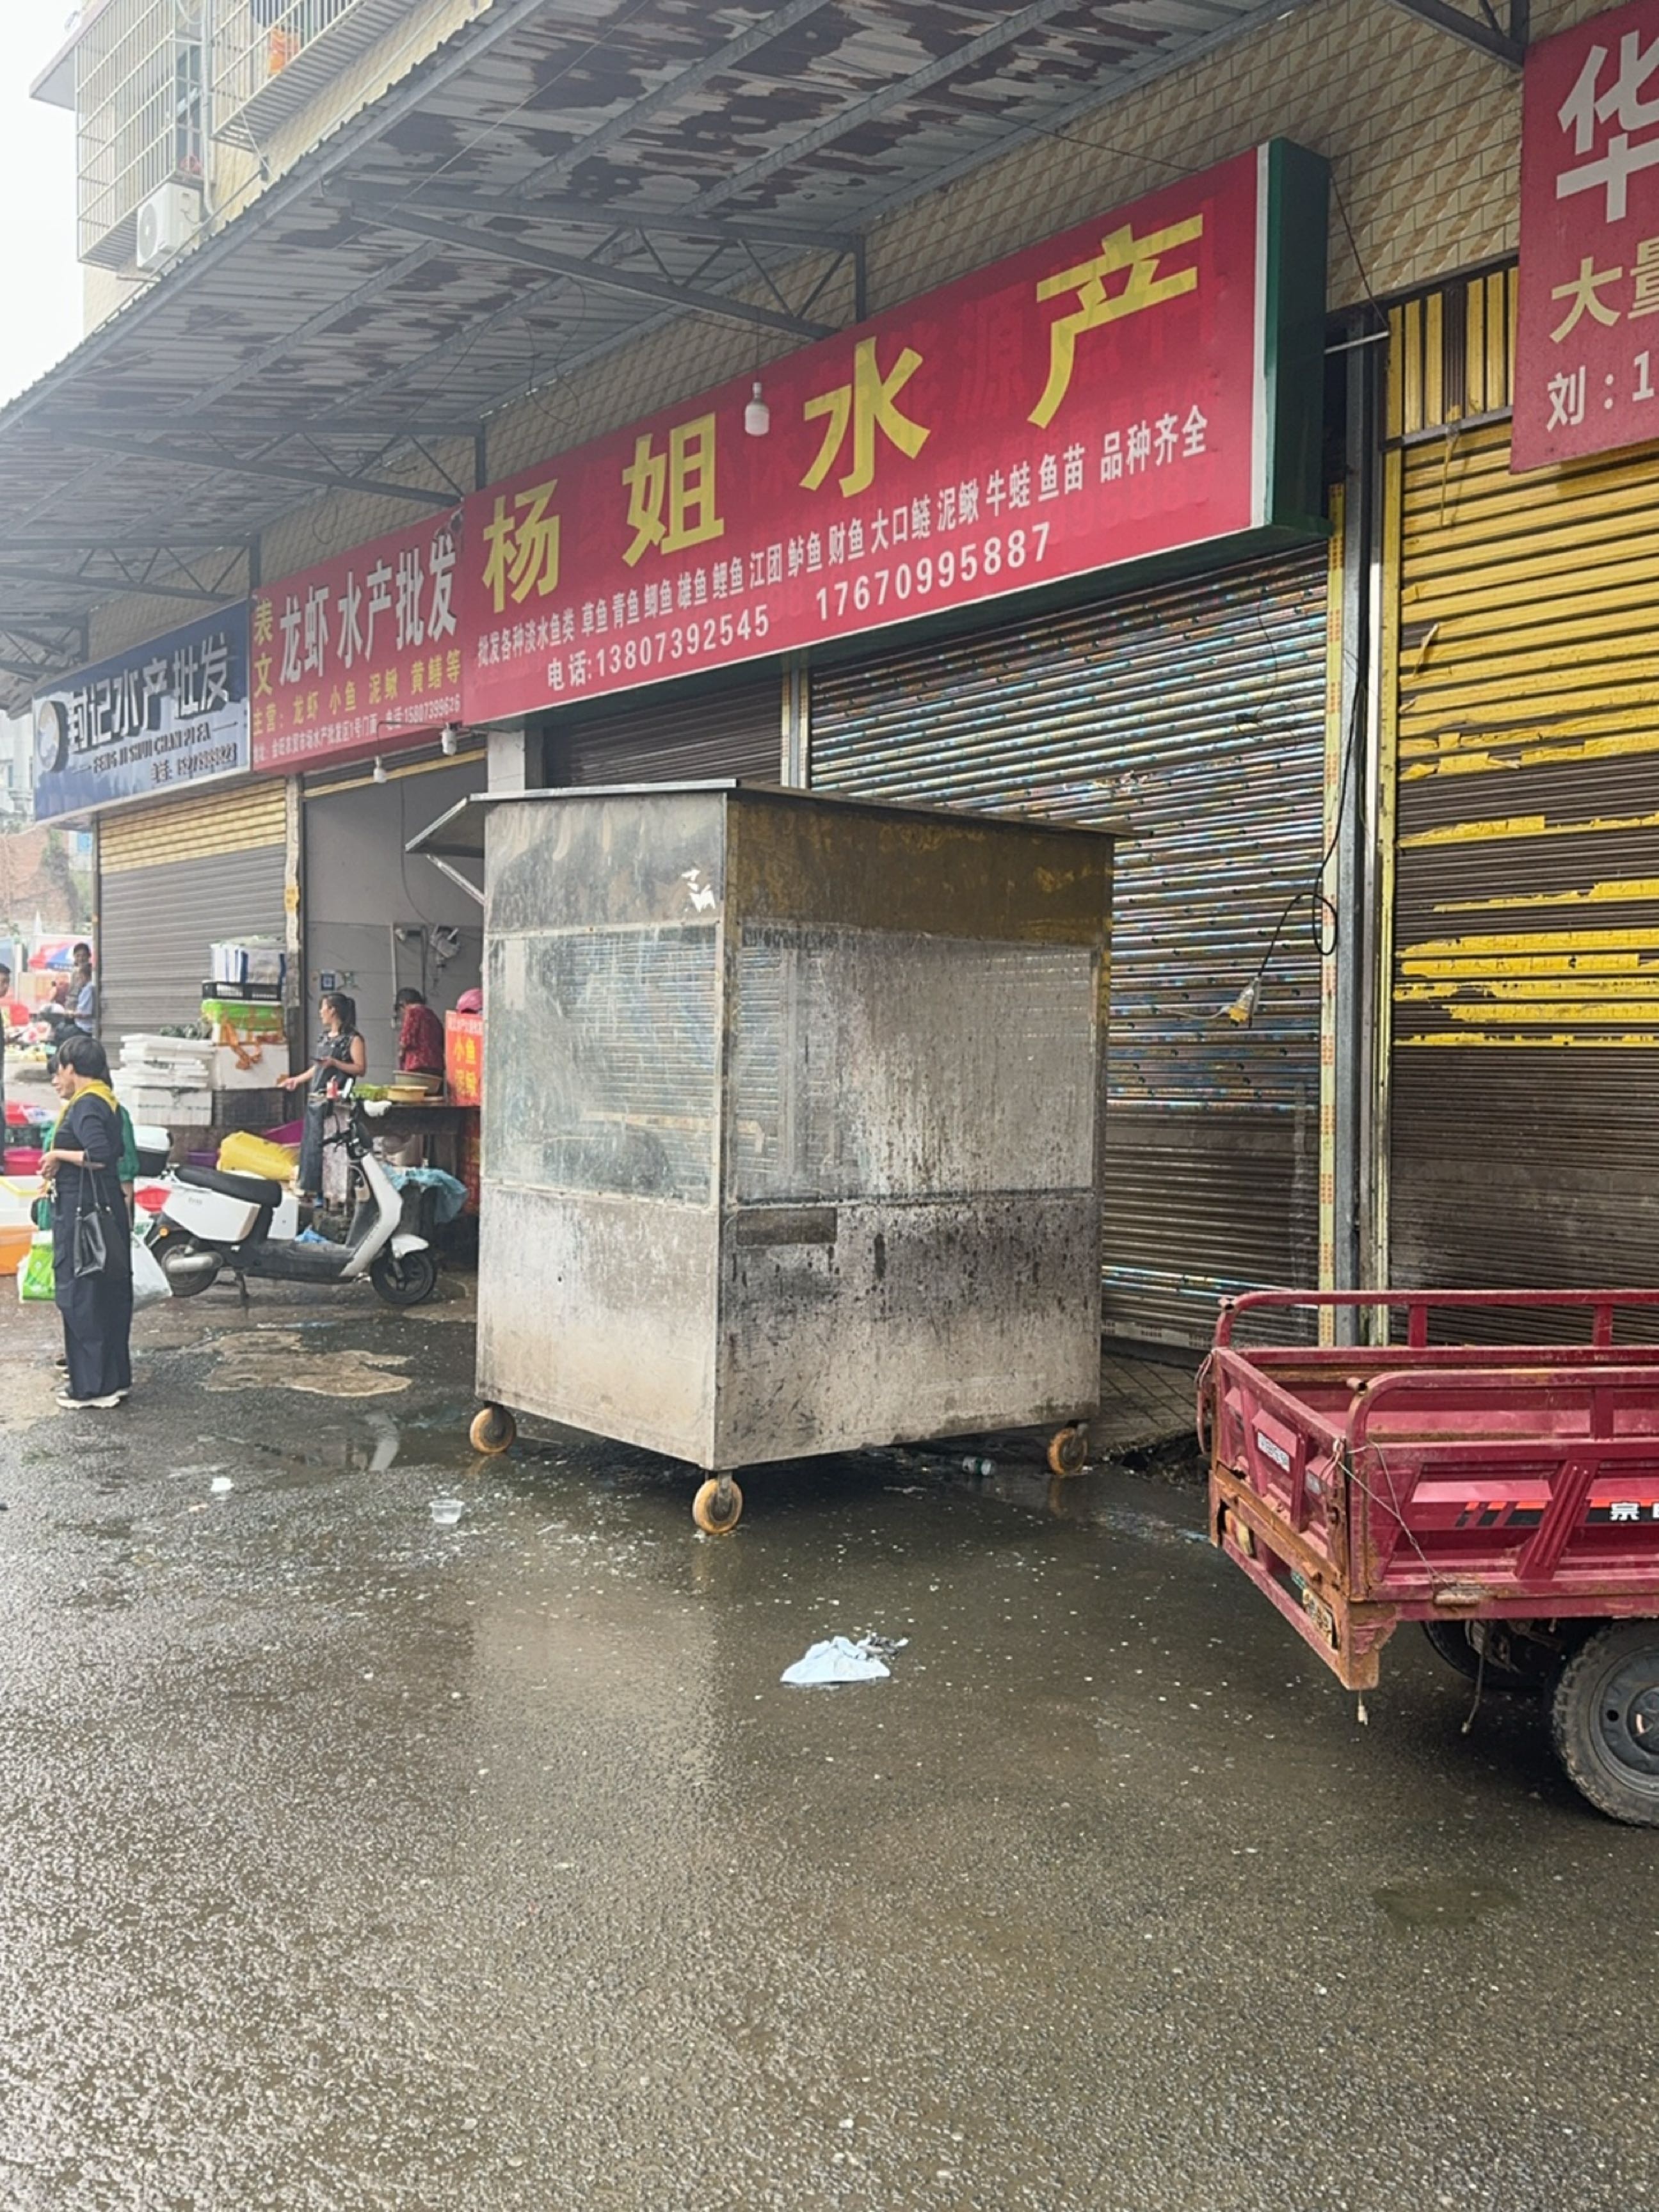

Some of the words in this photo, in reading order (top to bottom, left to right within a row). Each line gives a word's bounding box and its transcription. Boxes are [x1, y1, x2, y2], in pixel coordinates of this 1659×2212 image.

[483, 213, 1203, 613] 杨姐水产
[477, 607, 575, 668] 批发各种淡水鱼类
[581, 598, 608, 637] 草鱼
[613, 588, 640, 630] 青鱼
[712, 556, 744, 599] 鲤鱼
[749, 543, 783, 589] 江团
[787, 531, 822, 577] 鲈鱼
[829, 518, 865, 566] 财鱼
[937, 478, 979, 532] 泥鳅
[986, 460, 1031, 517] 牛蛙
[1038, 443, 1085, 502] 鱼苗
[1100, 403, 1208, 484] 品种齐全
[816, 521, 1050, 621] 17670995887
[280, 585, 329, 687] 龙虾
[337, 533, 458, 669] 水产批发
[547, 604, 769, 691] 电话:13807392545
[293, 691, 319, 725] 龙虾
[329, 681, 357, 716] 小鱼
[368, 668, 398, 704] 泥鳅
[1610, 1502, 1659, 1521] 宗
